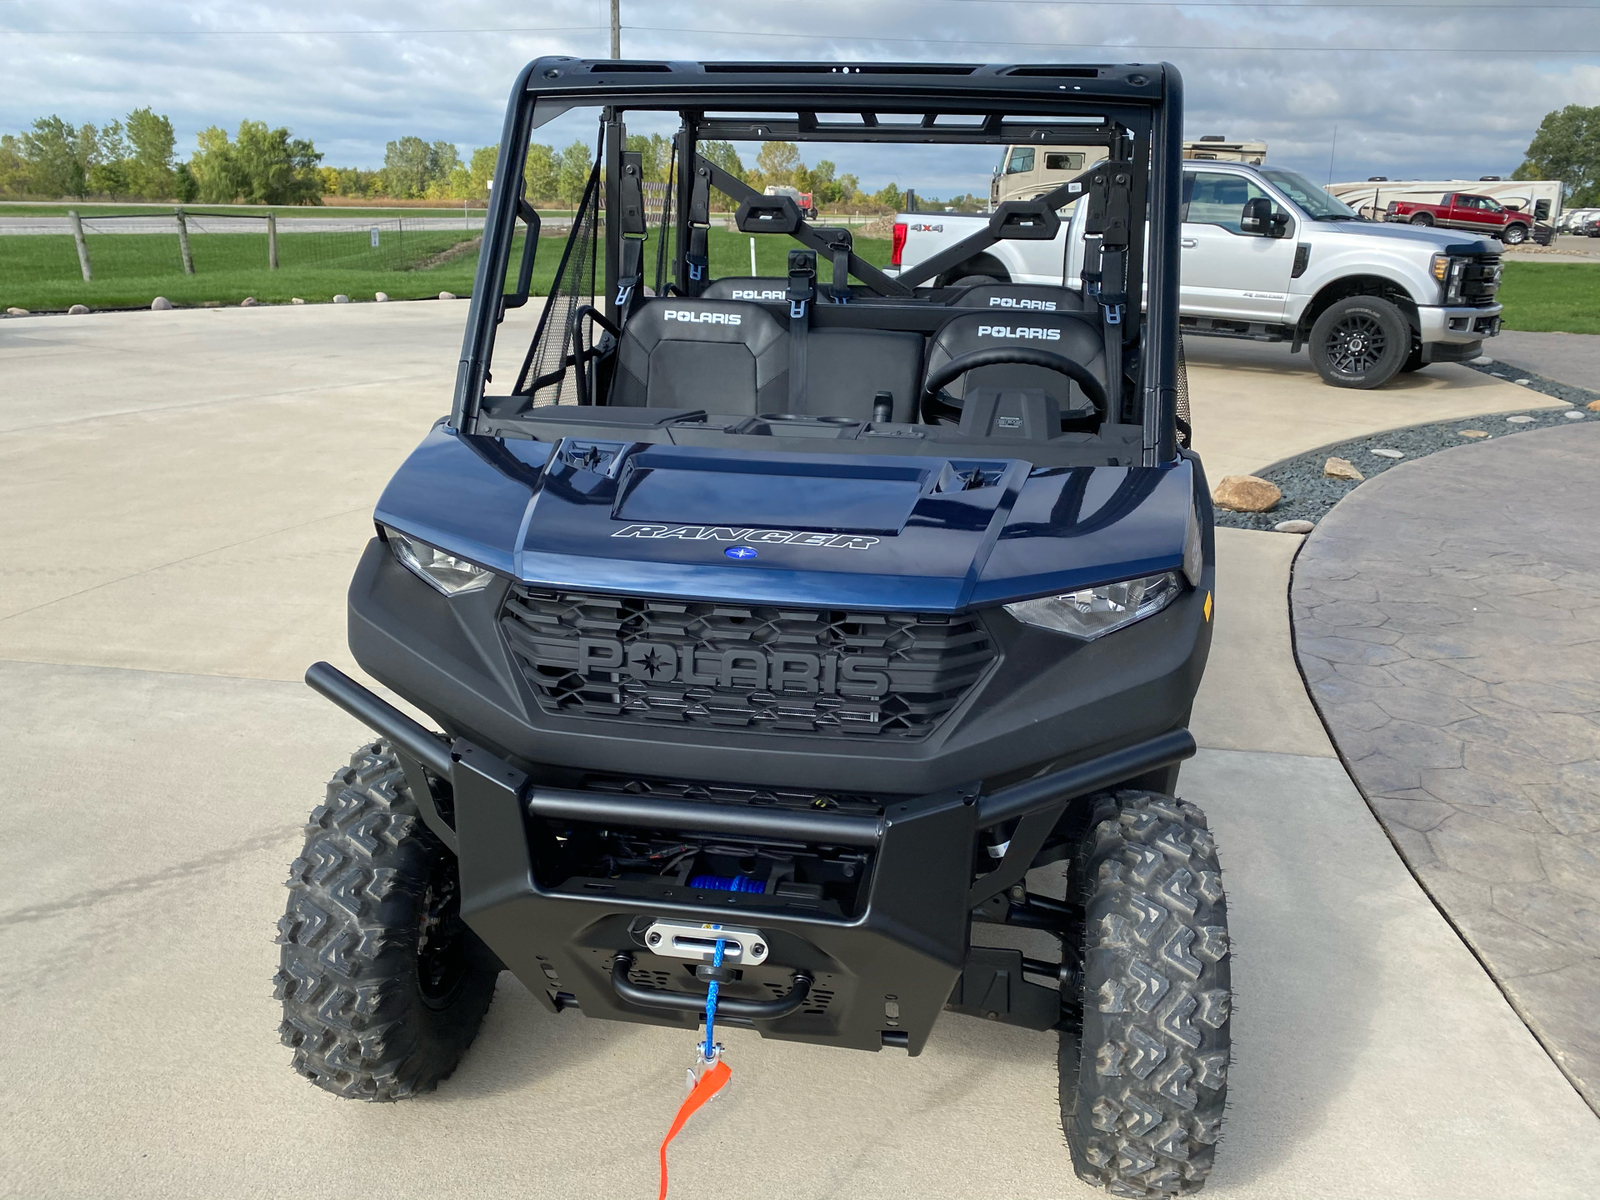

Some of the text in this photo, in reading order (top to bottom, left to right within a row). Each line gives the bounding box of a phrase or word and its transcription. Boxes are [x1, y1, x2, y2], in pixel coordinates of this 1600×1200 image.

[732, 289, 786, 300] POLARI
[989, 297, 1057, 311] POLARIS
[663, 309, 742, 327] POLARIS
[977, 325, 1062, 341] POLARIS
[611, 523, 881, 551] RANGER
[577, 637, 891, 697] POLARIS
